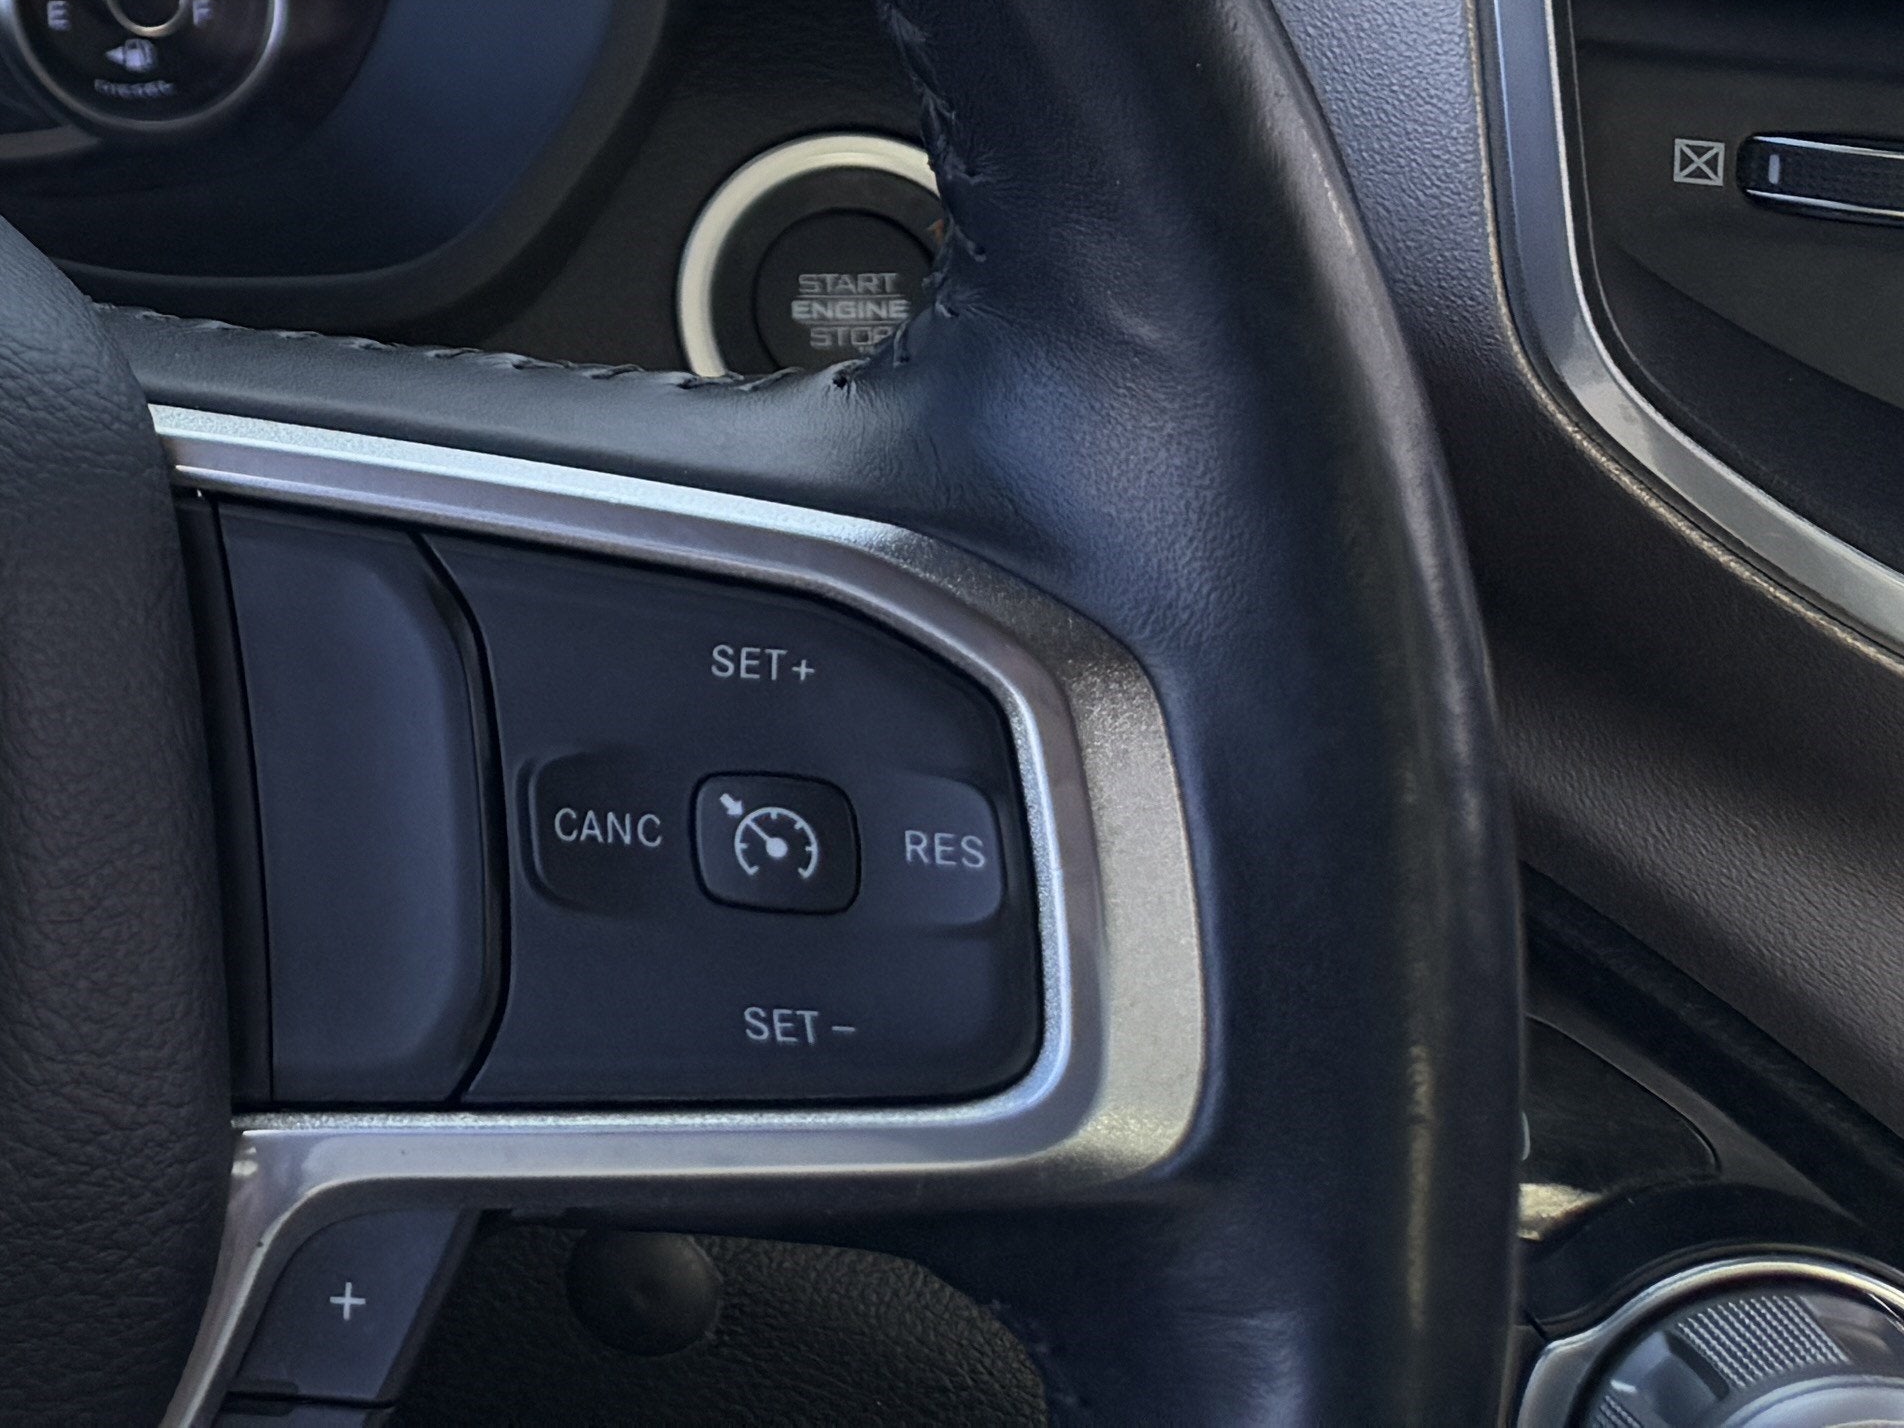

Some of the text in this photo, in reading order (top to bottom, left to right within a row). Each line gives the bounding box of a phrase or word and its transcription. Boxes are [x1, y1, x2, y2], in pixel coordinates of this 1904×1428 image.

[46, 0, 72, 31] E
[798, 273, 898, 294] START
[791, 299, 910, 320] ENGINE
[810, 326, 894, 348] STOP
[553, 807, 663, 848] CANC
[905, 829, 986, 869] RES
